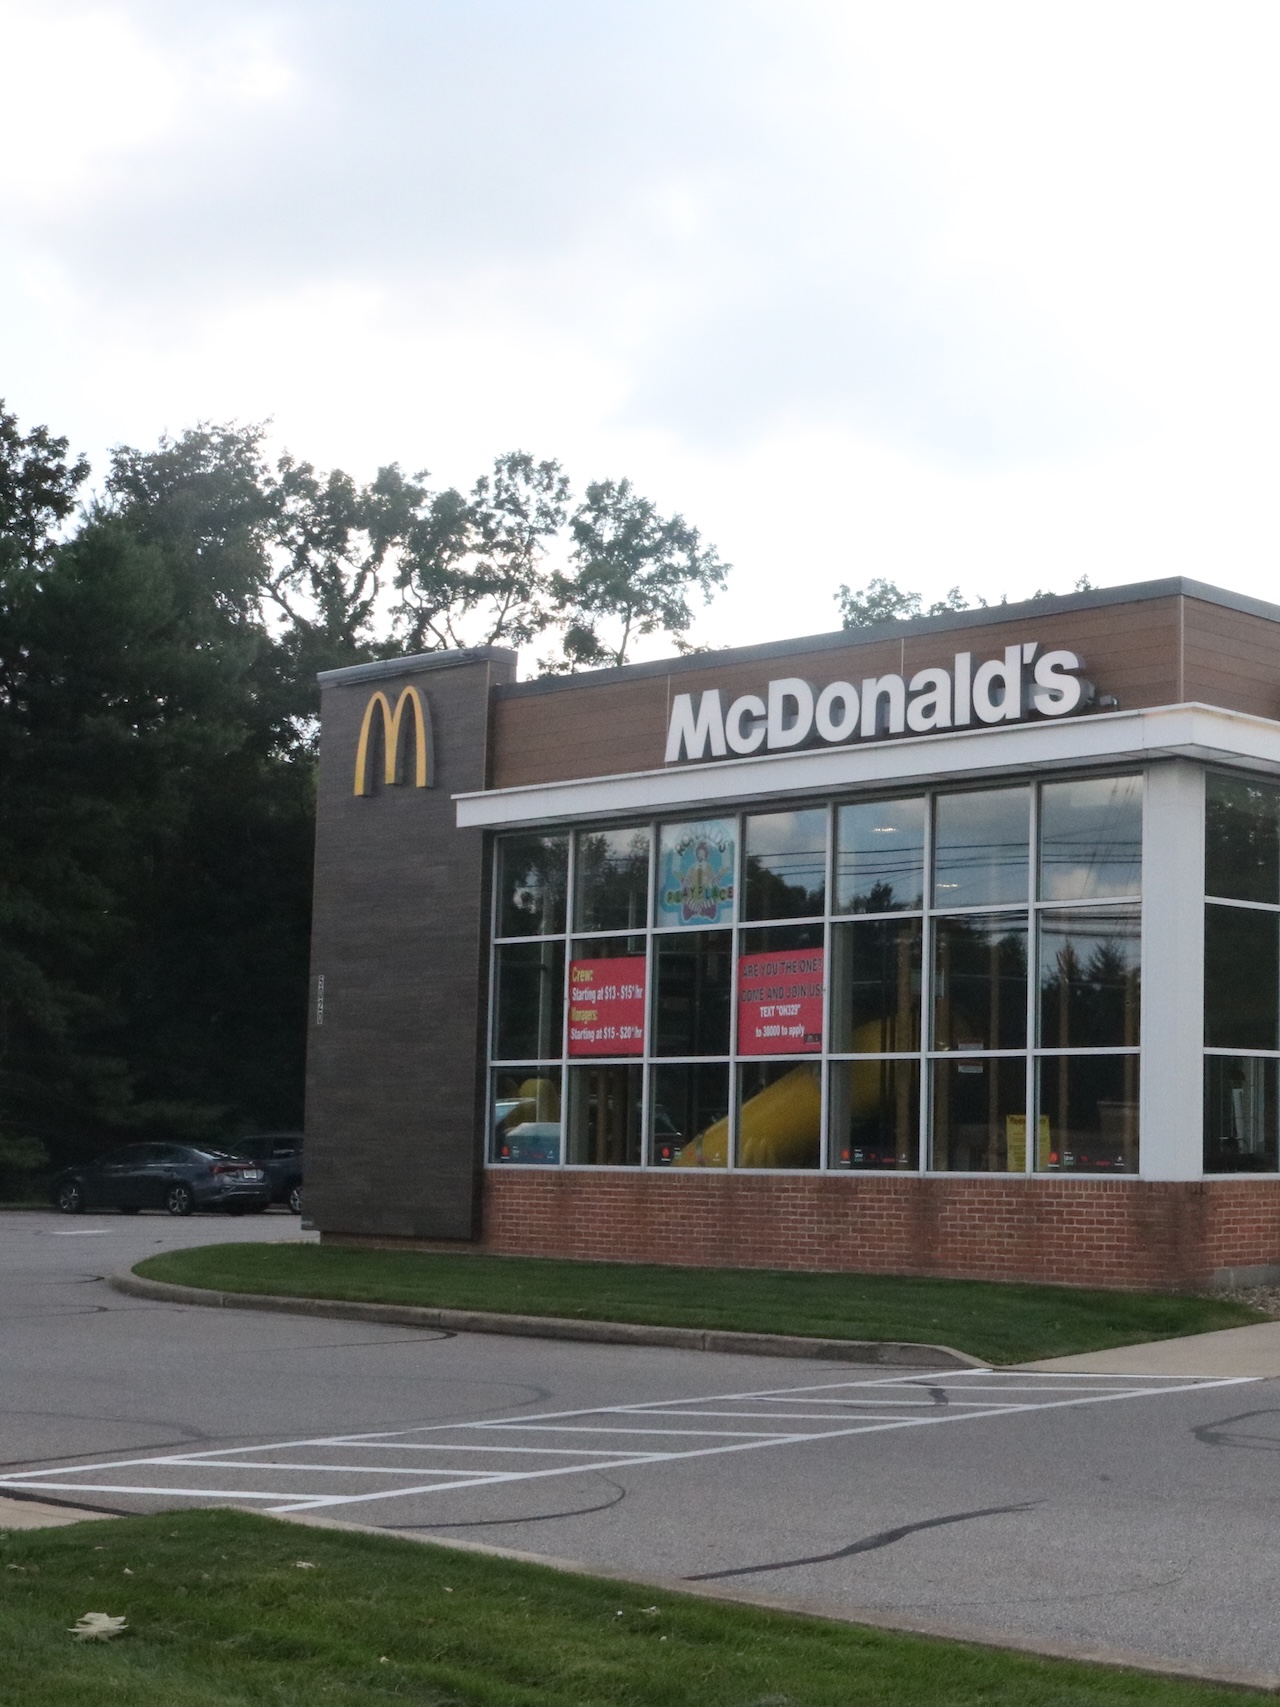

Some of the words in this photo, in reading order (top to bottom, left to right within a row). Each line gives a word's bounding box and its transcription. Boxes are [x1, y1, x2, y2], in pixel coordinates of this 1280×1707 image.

[664, 641, 1082, 763] McDonald's
[571, 966, 594, 982] Crew:
[743, 964, 758, 977] ARE
[762, 963, 778, 976] YOU
[781, 961, 797, 974] THE
[572, 986, 597, 1004] Starting
[597, 987, 604, 1000] at
[742, 988, 764, 1002] COME
[767, 986, 784, 999] AND
[787, 985, 806, 998] JOIN
[760, 1005, 775, 1018] TEXT
[570, 1028, 595, 1043] Starting
[595, 1028, 603, 1039] at
[755, 1027, 762, 1038] to
[781, 1025, 788, 1036] to
[788, 1023, 805, 1038] apply
